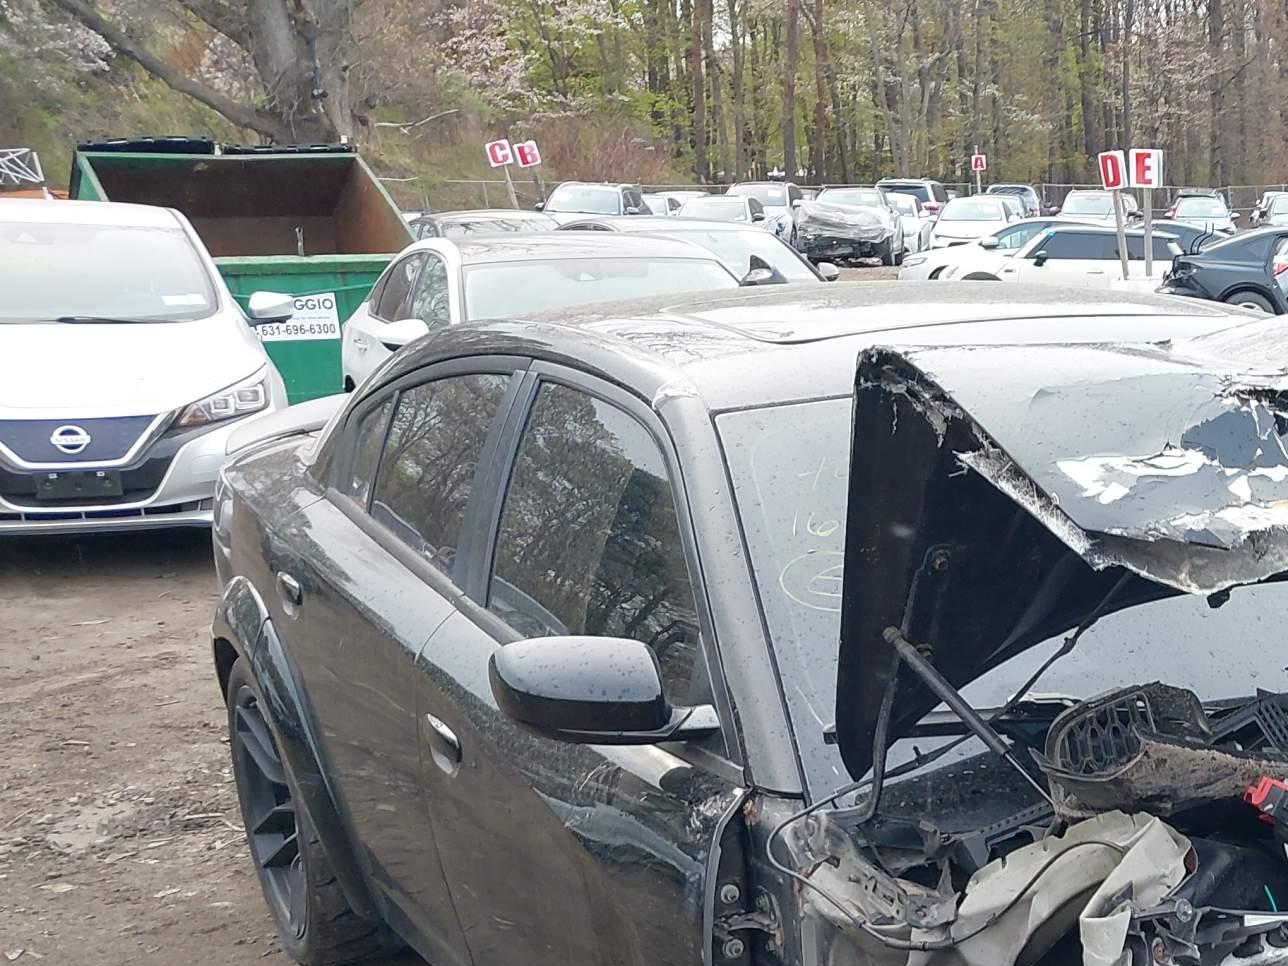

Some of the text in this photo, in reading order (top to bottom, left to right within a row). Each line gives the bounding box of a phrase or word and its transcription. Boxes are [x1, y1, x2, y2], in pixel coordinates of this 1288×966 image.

[489, 142, 509, 163] C
[517, 144, 539, 165] B
[974, 156, 984, 169] A
[1101, 154, 1121, 188] D
[1135, 152, 1152, 185] E
[293, 298, 334, 310] GGIO
[261, 323, 336, 336] 631-696-6300
